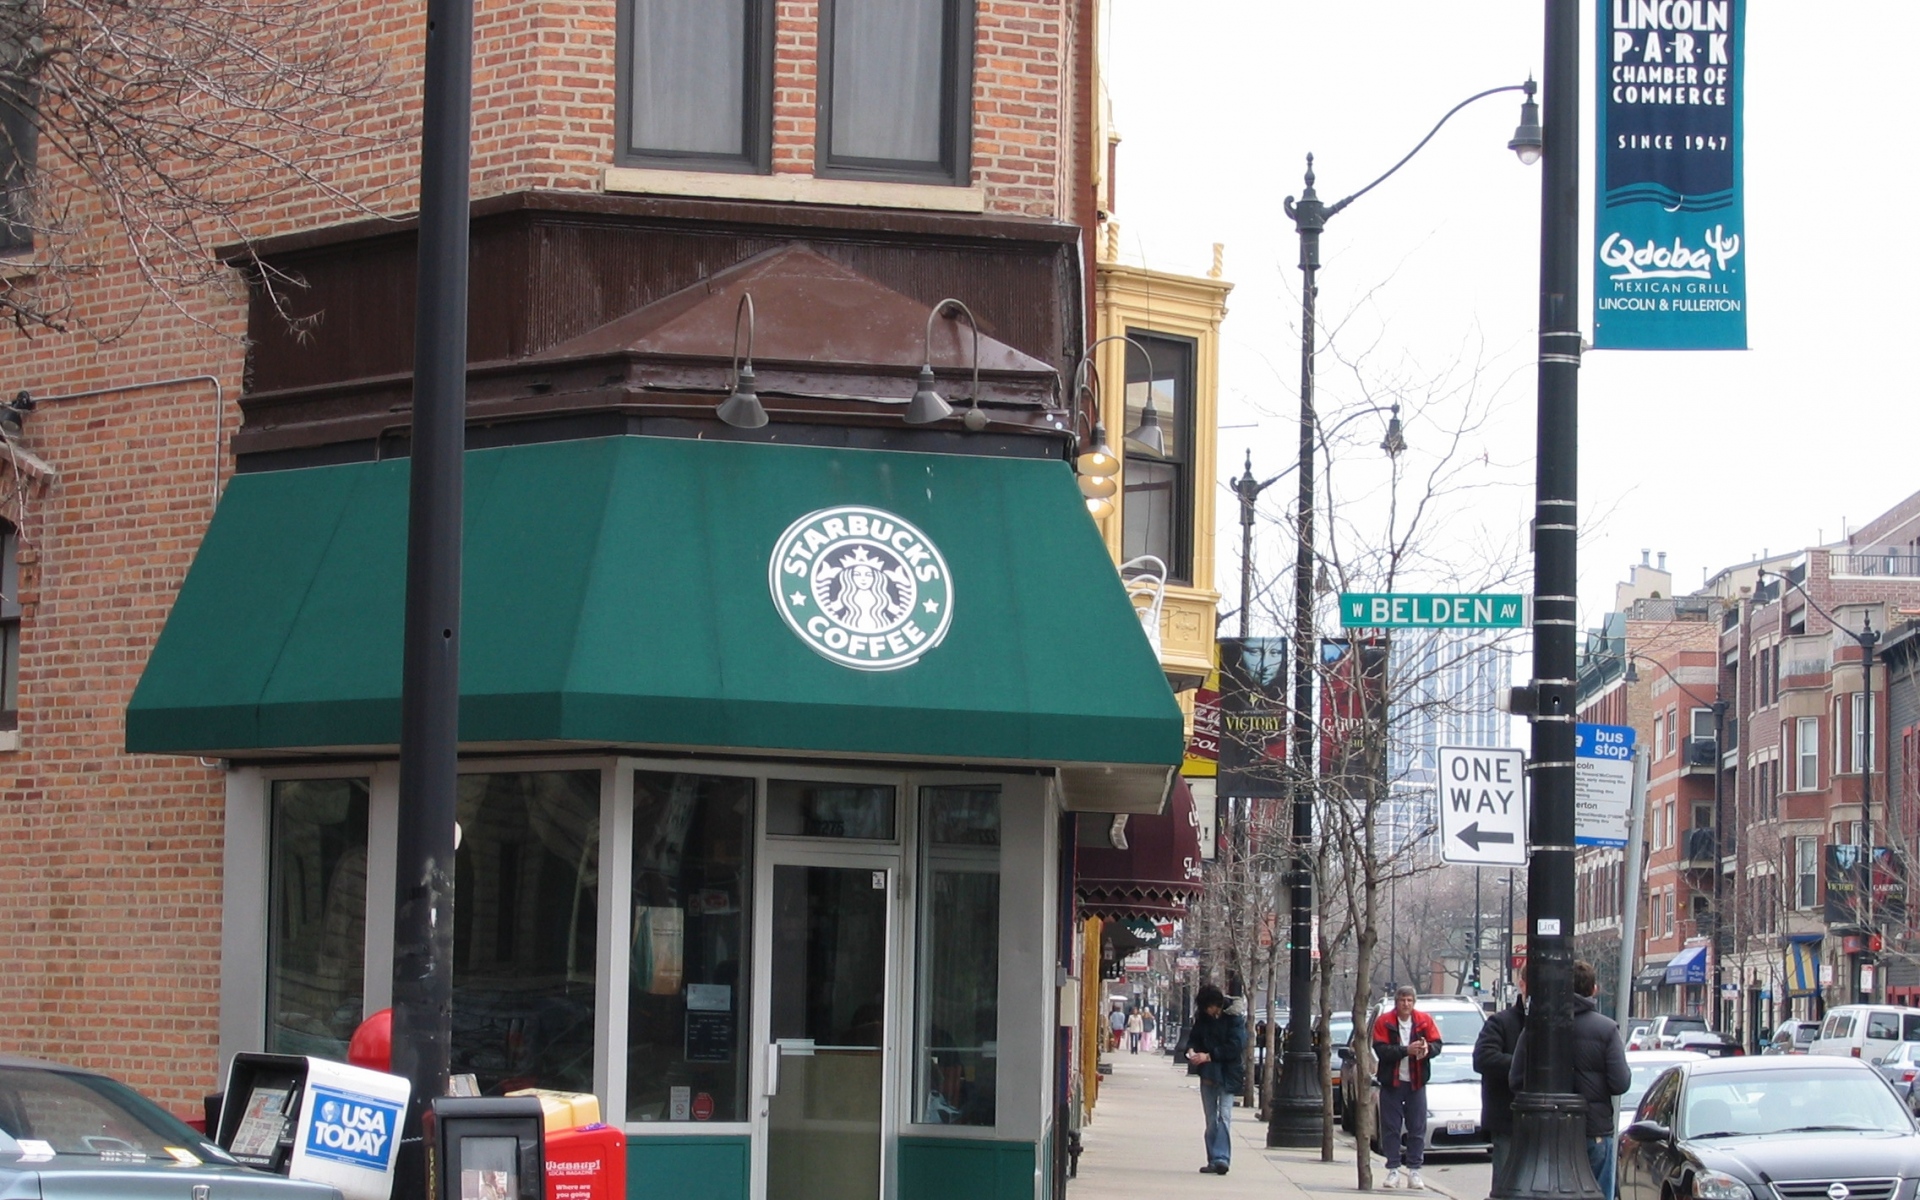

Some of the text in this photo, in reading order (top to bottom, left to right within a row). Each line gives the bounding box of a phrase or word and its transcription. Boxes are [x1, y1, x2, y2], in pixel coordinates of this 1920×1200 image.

[1613, 0, 1727, 31] LINCOLN
[1612, 66, 1727, 85] CHAMBER OF
[1612, 86, 1726, 106] COMMERCE
[1618, 135, 1727, 151] SINCE 1947
[1600, 232, 1712, 276] Qdoba
[1614, 282, 1729, 294] MEXICAN GRILL
[1599, 298, 1741, 312] LINCOLN & FULLERTON
[784, 515, 939, 582] STARBUCKS
[1352, 598, 1517, 623] W BELDEN AV
[807, 616, 926, 658] COFFEE
[1225, 716, 1280, 730] VICTORY
[1595, 729, 1624, 743] bus
[1594, 744, 1628, 759] stop
[1451, 756, 1512, 783] ONE
[1450, 787, 1514, 815] WAY
[341, 1103, 386, 1134] USA
[315, 1121, 388, 1156] TODAY
